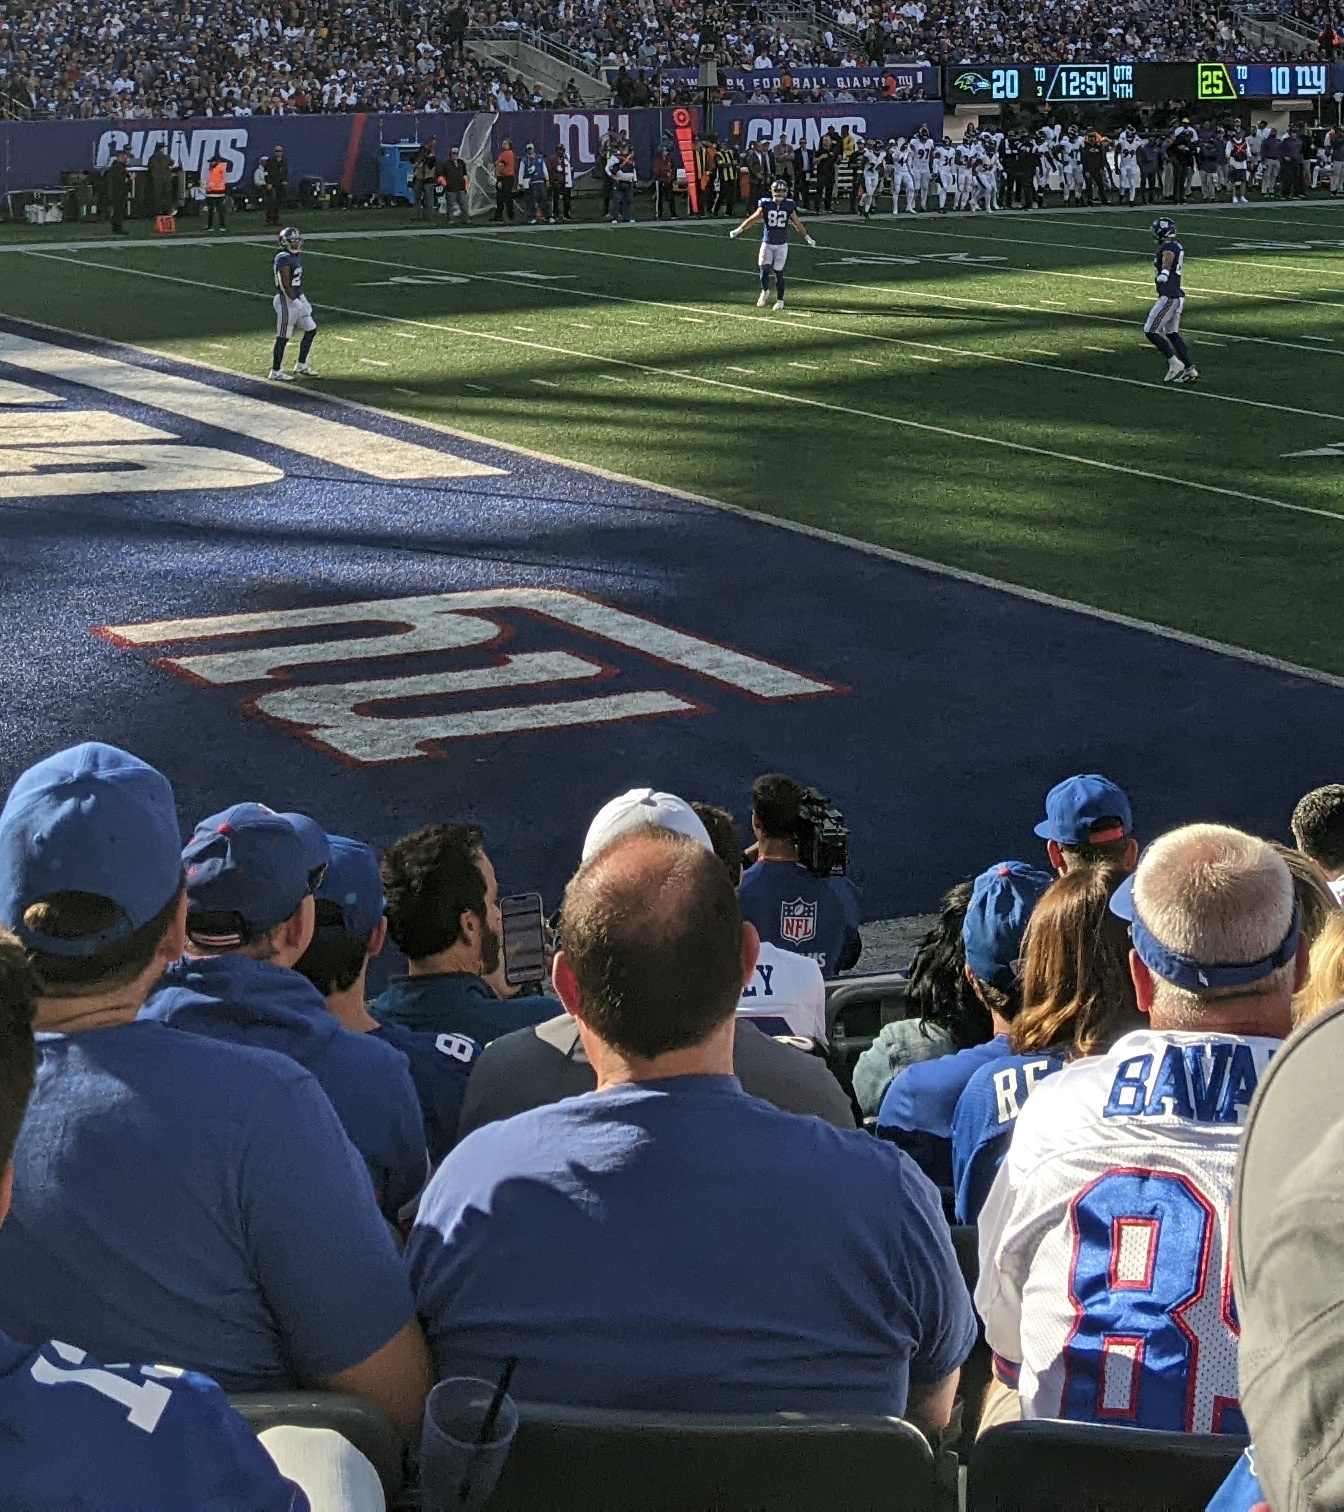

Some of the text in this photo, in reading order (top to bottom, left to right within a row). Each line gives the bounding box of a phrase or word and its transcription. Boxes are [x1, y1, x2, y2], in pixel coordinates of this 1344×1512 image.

[1034, 67, 1046, 83] TO
[1060, 70, 1107, 97] 12:54
[1113, 66, 1133, 82] QTR
[1201, 70, 1223, 94] 25
[1236, 66, 1248, 80] TO
[1270, 69, 1290, 94] 10
[1294, 66, 1326, 94] ny
[992, 70, 1019, 100] 20
[1036, 85, 1043, 97] 3
[1112, 83, 1134, 99] 4TH
[1238, 84, 1245, 95] 3
[767, 210, 788, 229] 82
[783, 917, 813, 940] NFL
[1103, 1043, 1268, 1124] BAVA
[1061, 1167, 1246, 1434] 8
